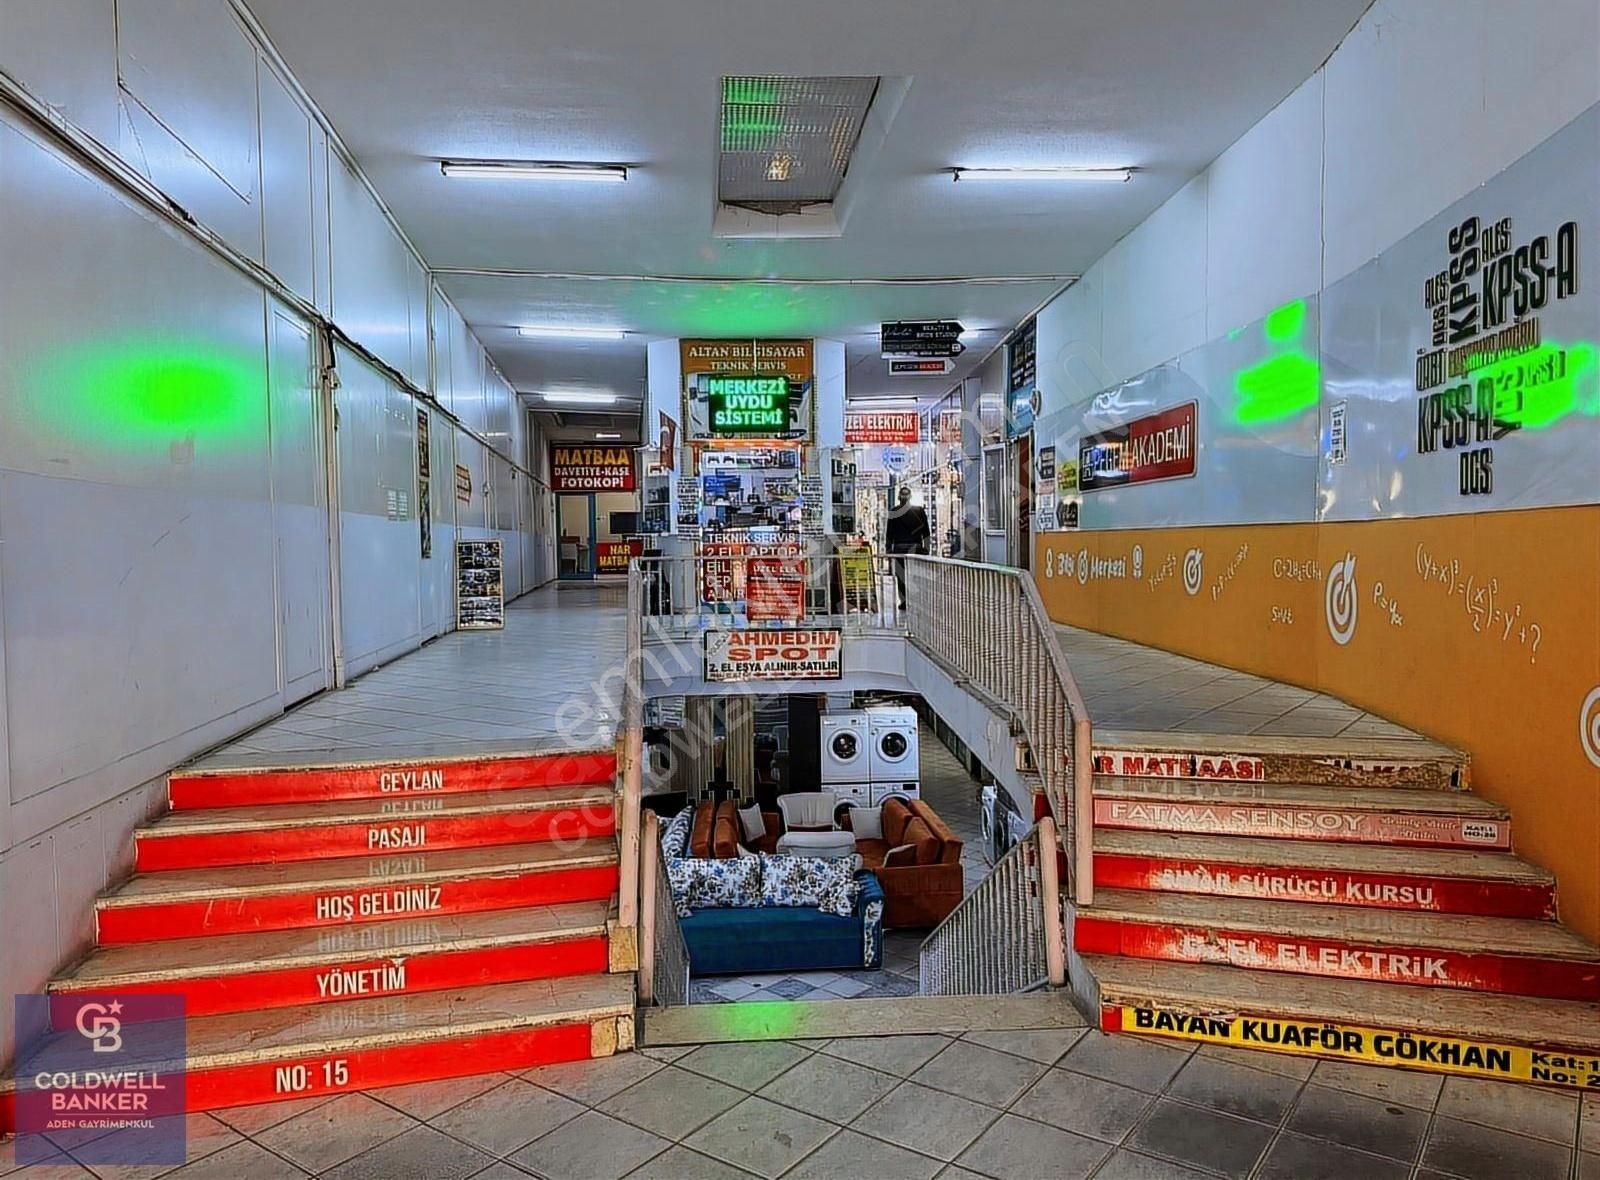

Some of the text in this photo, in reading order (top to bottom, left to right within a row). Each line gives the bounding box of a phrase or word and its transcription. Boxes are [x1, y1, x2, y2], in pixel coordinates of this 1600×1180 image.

[1482, 218, 1512, 262] ALES
[1449, 216, 1480, 345] KPSS
[1482, 221, 1578, 330] KPSS-A
[689, 346, 729, 357] ALTAN
[710, 377, 786, 394] MERKEZİ
[715, 408, 783, 425] SİSTEMİ
[726, 395, 773, 409] UYDU
[1417, 376, 1494, 454] KPSS-A
[555, 448, 630, 465] MATBAA
[1131, 416, 1190, 468] AKADEMİ
[1459, 448, 1493, 496] DGS
[721, 663, 733, 672] EL
[728, 647, 835, 661] SPOT
[380, 770, 443, 792] CEYLAN
[1112, 803, 1222, 824] FATMA
[368, 825, 426, 849] PASAJI
[317, 884, 442, 920] HOŞ GELDİNİZ
[1239, 872, 1338, 898] SÜRÜCÜ
[1347, 880, 1433, 904] KURSU
[317, 963, 406, 997] YÖNETİM
[1134, 1007, 1511, 1073] BAYAN KUAFÖR GÖKHAN
[276, 1060, 348, 1094] NO: 15
